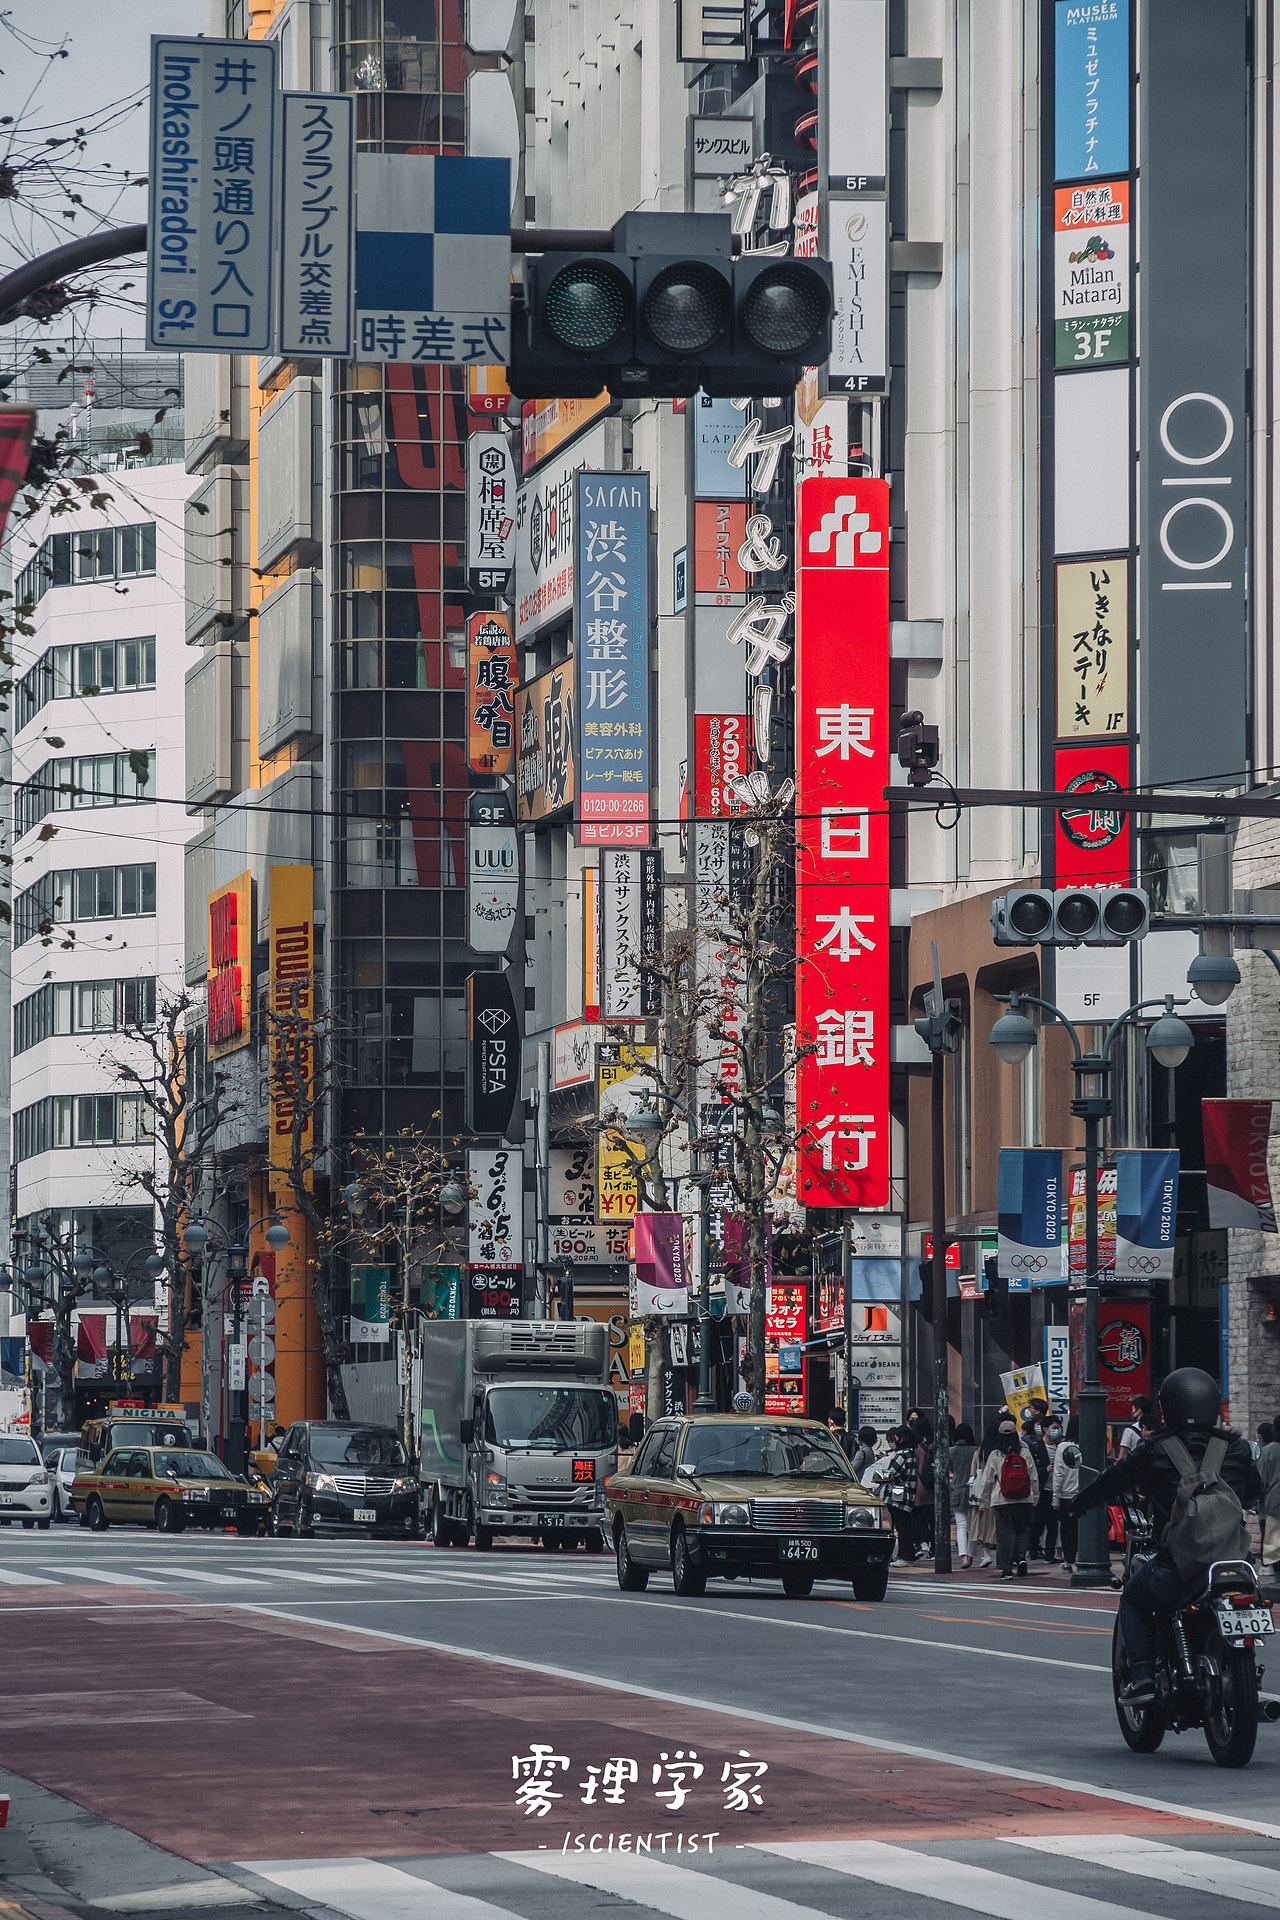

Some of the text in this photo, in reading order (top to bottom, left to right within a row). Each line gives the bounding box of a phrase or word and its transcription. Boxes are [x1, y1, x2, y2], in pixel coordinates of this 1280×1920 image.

[1067, 12, 1118, 26] PLATINUM
[1085, 27, 1100, 172] ミュゼプラチナム
[695, 138, 750, 155] サンクスビル
[846, 177, 867, 190] 5F
[158, 56, 201, 338] Inokashiradori St.
[211, 57, 257, 338] 井ノ頭通り入口
[1071, 186, 1114, 208] 自然派
[299, 105, 334, 346] スクランブル交差点
[1061, 204, 1123, 228] インド料理
[1070, 267, 1115, 287] Milan
[1062, 282, 1122, 306] Nataraj
[848, 247, 865, 364] EMISHIA
[361, 316, 507, 363] 時差式
[1074, 329, 1112, 361] 3F
[844, 376, 868, 391] 4F
[484, 398, 506, 408] 6F
[478, 476, 508, 560] 相席屋
[716, 505, 731, 589] アイワホーム
[478, 571, 506, 588] 5F
[715, 595, 731, 605] 6F
[585, 520, 629, 710] 渋谷整形
[630, 521, 645, 711] http://www.2266.co.jp
[1090, 569, 1113, 675] いきなり
[1073, 631, 1093, 726] ステーキ
[584, 722, 643, 737] 美容外科
[478, 754, 500, 768] 4F
[585, 748, 644, 760] ピアス穴あけ
[585, 770, 643, 783] レーザー脱毛
[478, 807, 505, 825] 3F
[584, 799, 644, 813] 0120-00-2266
[584, 825, 645, 839] 当ビル3F
[614, 854, 631, 1013] 渋谷サンクスクリニック
[814, 703, 876, 1173] 東日本銀行
[1084, 994, 1100, 1006] 5F
[489, 1040, 506, 1094] PSFA
[1046, 1177, 1057, 1240] TOKYO 2020
[1160, 1178, 1174, 1241] TOKYO 2020
[477, 1224, 496, 1261] 酒場
[673, 1263, 682, 1283] 2020
[481, 1291, 519, 1307] 190円
[1098, 1327, 1143, 1363] 一蘭
[122, 1408, 177, 1419] NIGITA
[574, 1461, 594, 1471] 高圧
[574, 1471, 594, 1481] ガス
[787, 1547, 818, 1559] 64-70
[1222, 1619, 1273, 1634] 94-02
